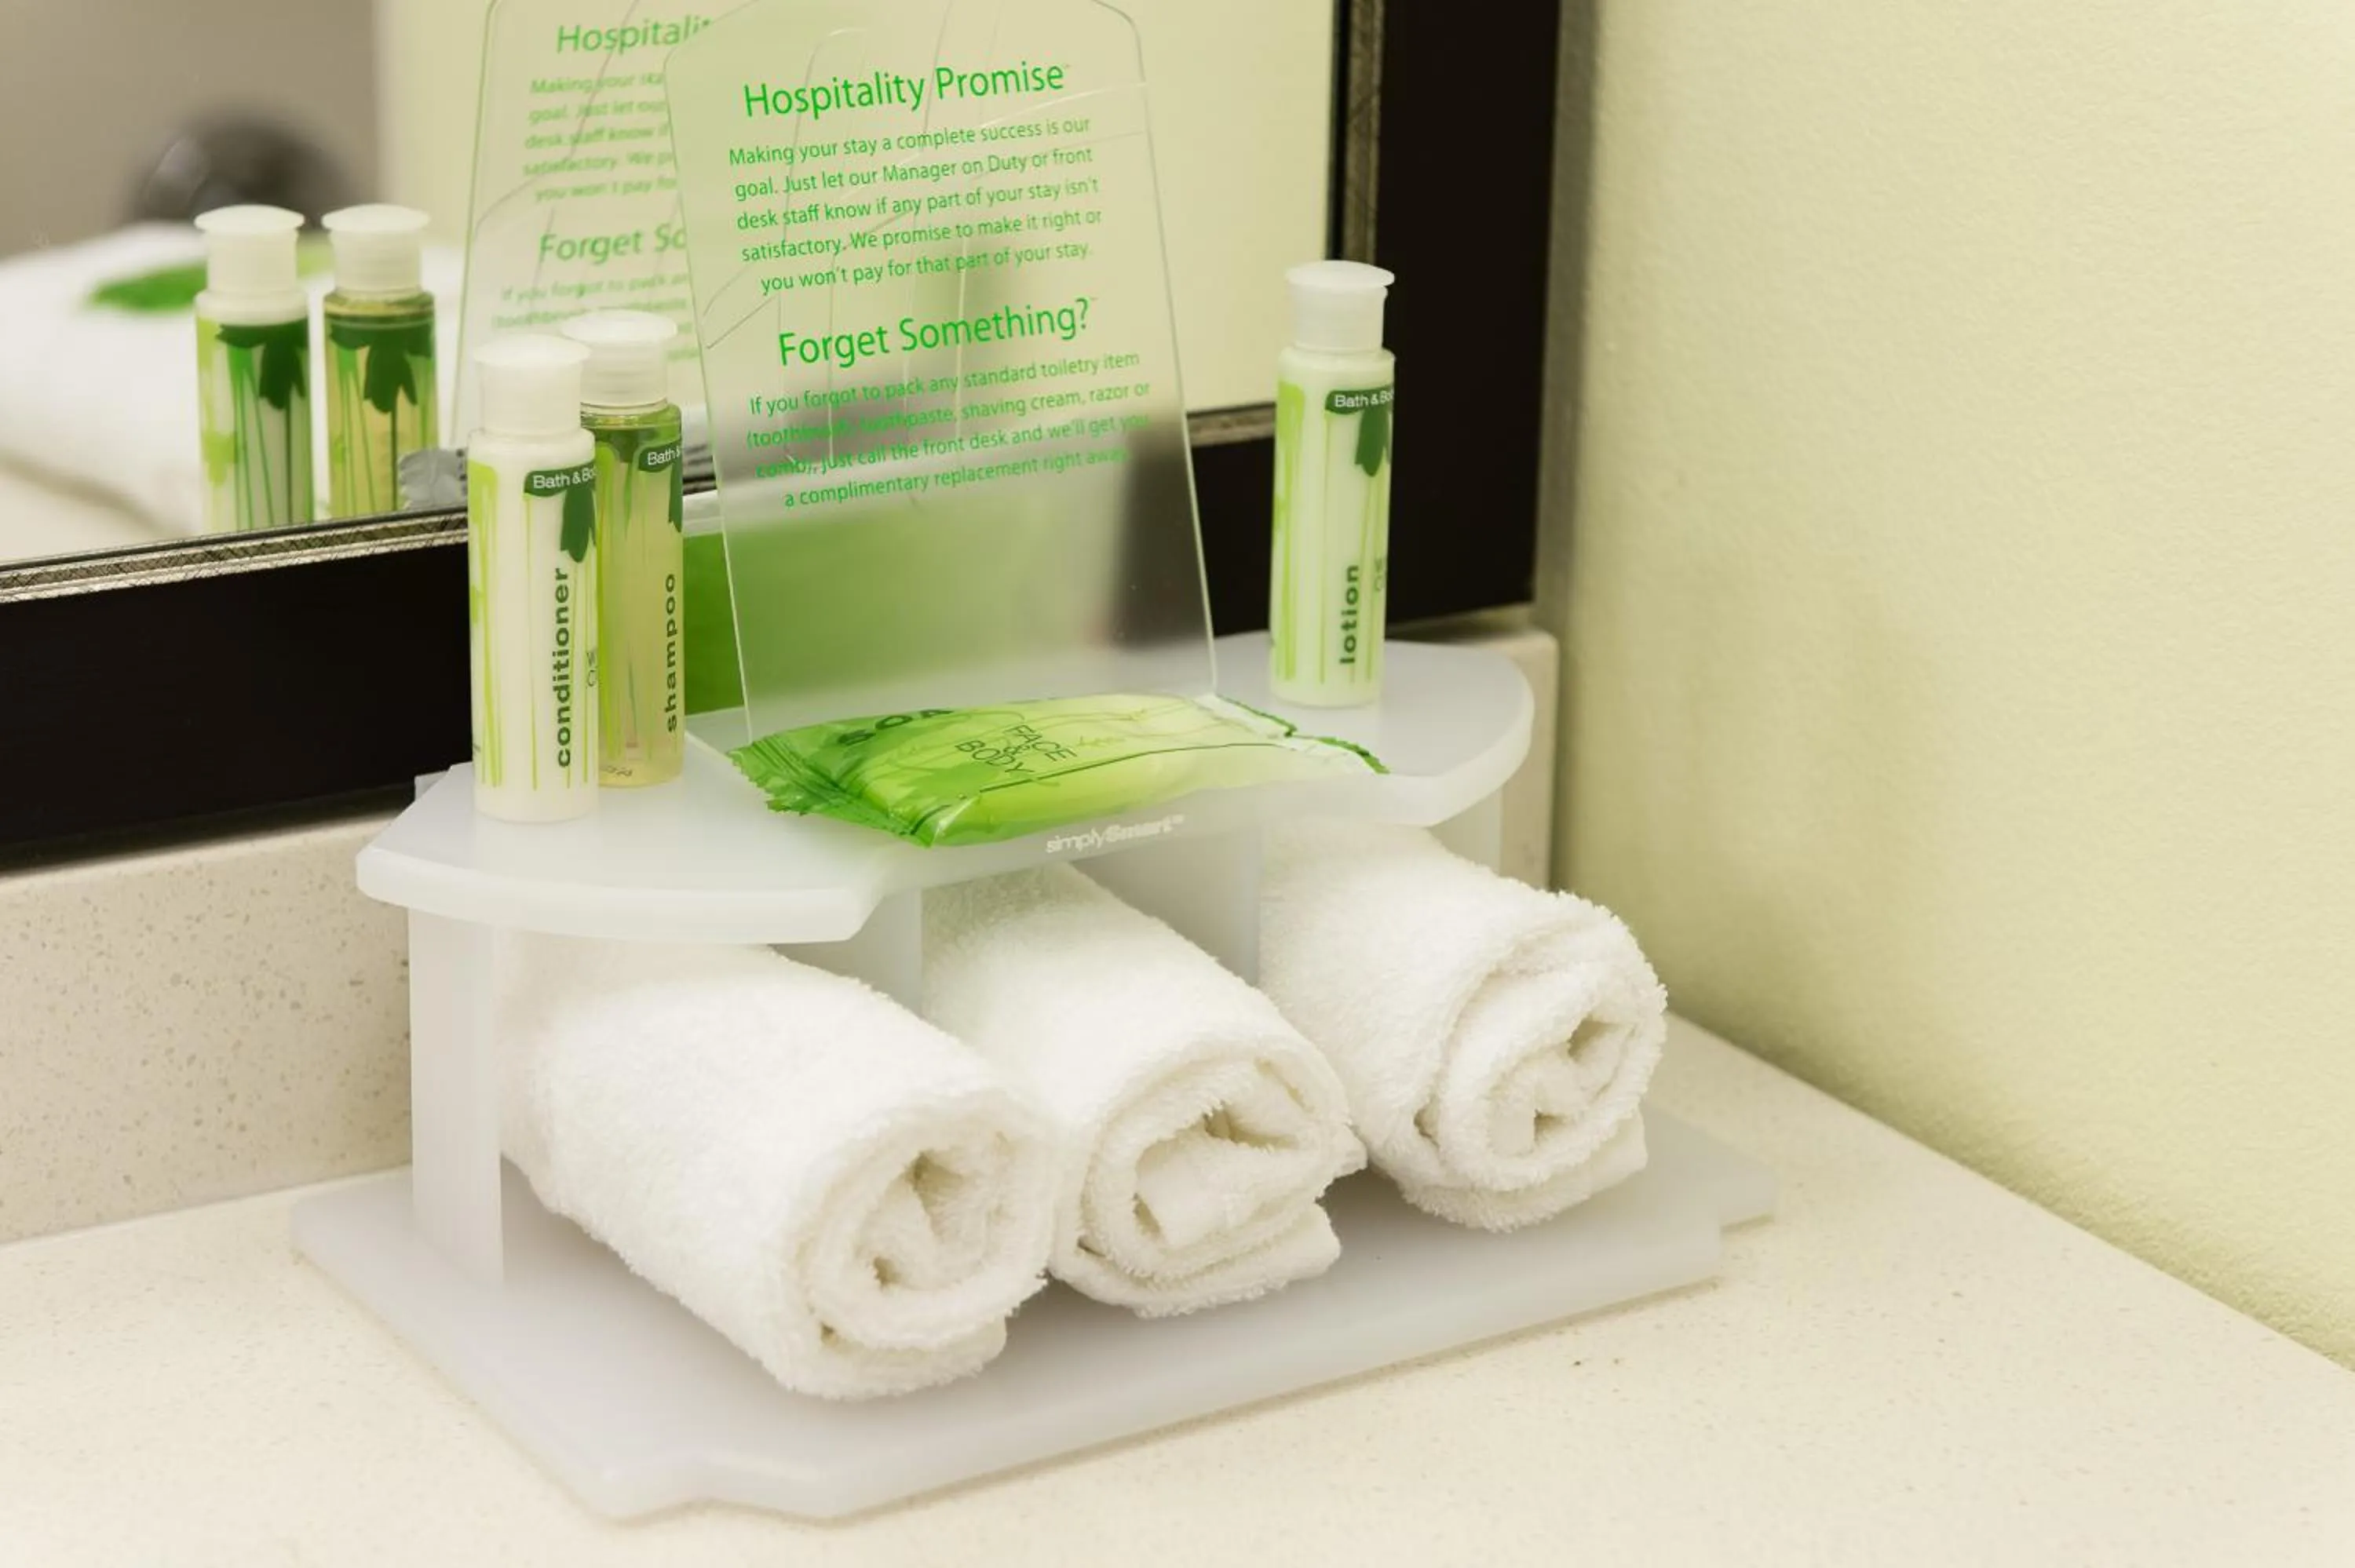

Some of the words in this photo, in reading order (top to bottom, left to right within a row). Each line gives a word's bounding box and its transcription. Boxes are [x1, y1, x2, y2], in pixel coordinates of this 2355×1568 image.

[556, 15, 710, 54] Hospitali
[743, 72, 925, 119] Hospitality
[935, 61, 1064, 99] Promise
[729, 145, 794, 166] Making
[799, 142, 838, 162] your
[843, 139, 877, 155] stay
[882, 137, 892, 151] a
[896, 126, 976, 149] complete
[981, 122, 1042, 141] success
[1046, 119, 1059, 135] is
[1063, 119, 1090, 133] our
[735, 176, 778, 202] goal.
[783, 175, 817, 193] Just
[822, 170, 845, 188] let
[849, 170, 878, 186] our
[883, 164, 957, 182] Manager
[962, 161, 984, 174] on
[988, 155, 1028, 173] Duty
[1031, 153, 1049, 167] or
[1052, 148, 1093, 164] front
[737, 209, 779, 230] desk
[783, 203, 820, 225] staff
[825, 203, 871, 220] know
[876, 195, 888, 214] if
[892, 199, 921, 216] any
[927, 192, 962, 213] part
[966, 187, 982, 205] of
[987, 188, 1024, 207] your
[1028, 183, 1061, 200] stay
[1065, 177, 1099, 195] isn't
[540, 230, 642, 265] Forget
[741, 239, 847, 262] satisfactory.
[850, 232, 878, 250] We
[882, 226, 951, 250] promise
[955, 224, 973, 238] to
[977, 217, 1022, 235] make
[1026, 214, 1039, 230] it
[1042, 210, 1082, 232] right
[1086, 210, 1102, 224] or
[761, 275, 794, 297] you
[799, 267, 848, 287] won't
[853, 266, 883, 286] pay
[888, 260, 912, 277] for
[916, 256, 950, 275] that
[955, 253, 989, 272] part
[994, 246, 1011, 265] of
[1015, 246, 1051, 268] your
[779, 324, 890, 367] Forget
[898, 297, 1090, 352] Something?
[750, 396, 762, 414] If
[766, 396, 799, 418] you
[803, 387, 857, 408] forgot
[862, 385, 881, 400] to
[885, 377, 923, 401] pack
[928, 376, 958, 394] any
[964, 362, 1037, 388] standard
[1042, 358, 1099, 377] toiletry
[1104, 352, 1140, 370] item
[961, 397, 1027, 417] shaving
[1030, 391, 1086, 410] cream,
[1089, 385, 1130, 403] razor
[1134, 382, 1150, 396] or
[1335, 395, 1369, 407] Bath
[1371, 393, 1379, 406] &
[647, 449, 675, 465] Bath
[821, 452, 853, 475] just
[857, 444, 886, 465] call
[890, 442, 918, 461] the
[923, 439, 964, 456] front
[969, 429, 1006, 450] desk
[1012, 425, 1043, 444] and
[1047, 418, 1086, 439] we'll
[1088, 416, 1116, 438] get
[533, 474, 571, 489] Bath
[571, 472, 581, 484] &
[785, 493, 794, 507] a
[799, 473, 929, 505] complimentary
[934, 458, 1039, 488] replacement
[1042, 452, 1081, 474] right
[1339, 565, 1359, 663] lotion
[552, 567, 571, 768] conditioner
[664, 573, 677, 733] shampoo
[837, 709, 953, 746] SOA
[1005, 724, 1077, 762] FACE
[955, 740, 1035, 774] BODY
